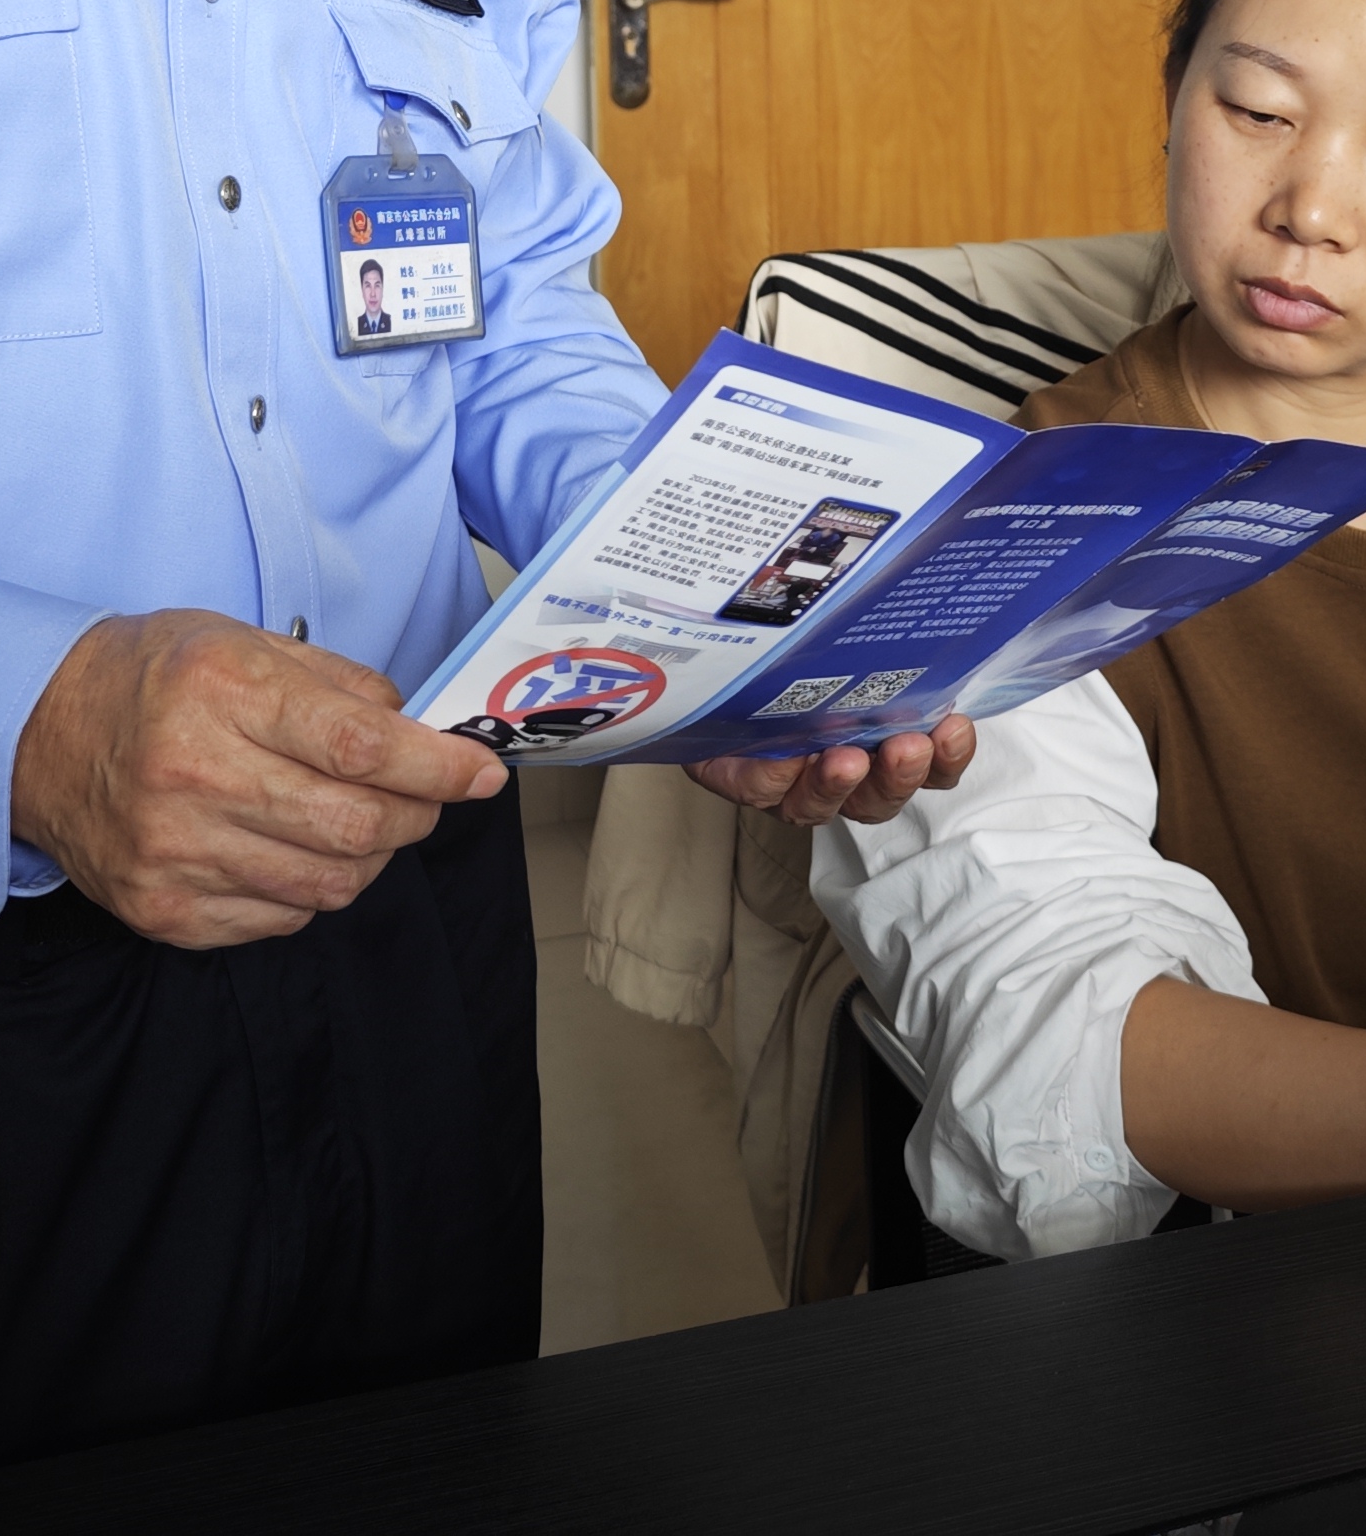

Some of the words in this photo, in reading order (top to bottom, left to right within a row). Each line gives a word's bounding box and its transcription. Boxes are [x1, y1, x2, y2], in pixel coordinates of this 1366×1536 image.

[376, 207, 461, 224] 南京市公安局六合分局
[432, 284, 457, 296] 218584
[543, 594, 653, 628] 网络不是法外之地
